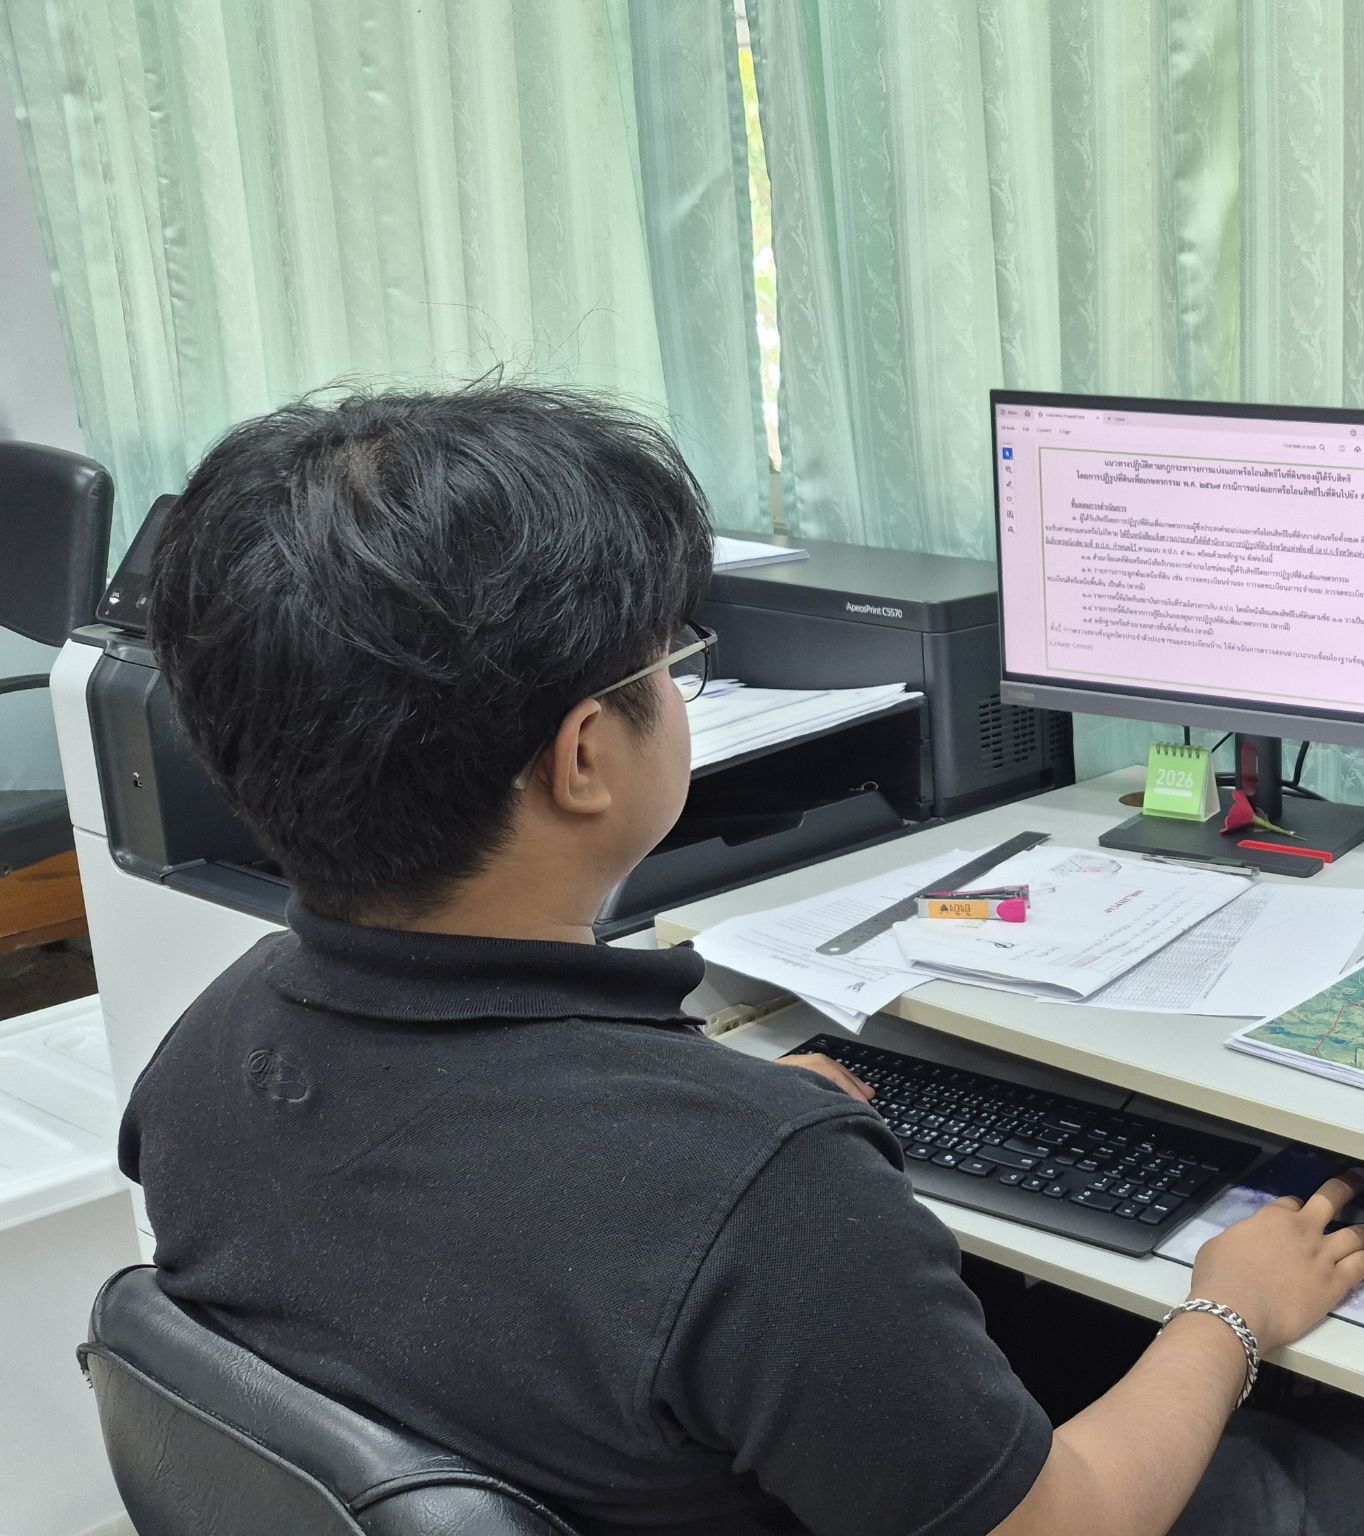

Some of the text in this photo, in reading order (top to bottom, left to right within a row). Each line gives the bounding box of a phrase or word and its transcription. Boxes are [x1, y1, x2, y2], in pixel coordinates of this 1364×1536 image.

[846, 602, 903, 618] ApeosPrint C5570
[1156, 768, 1194, 788] 2026
